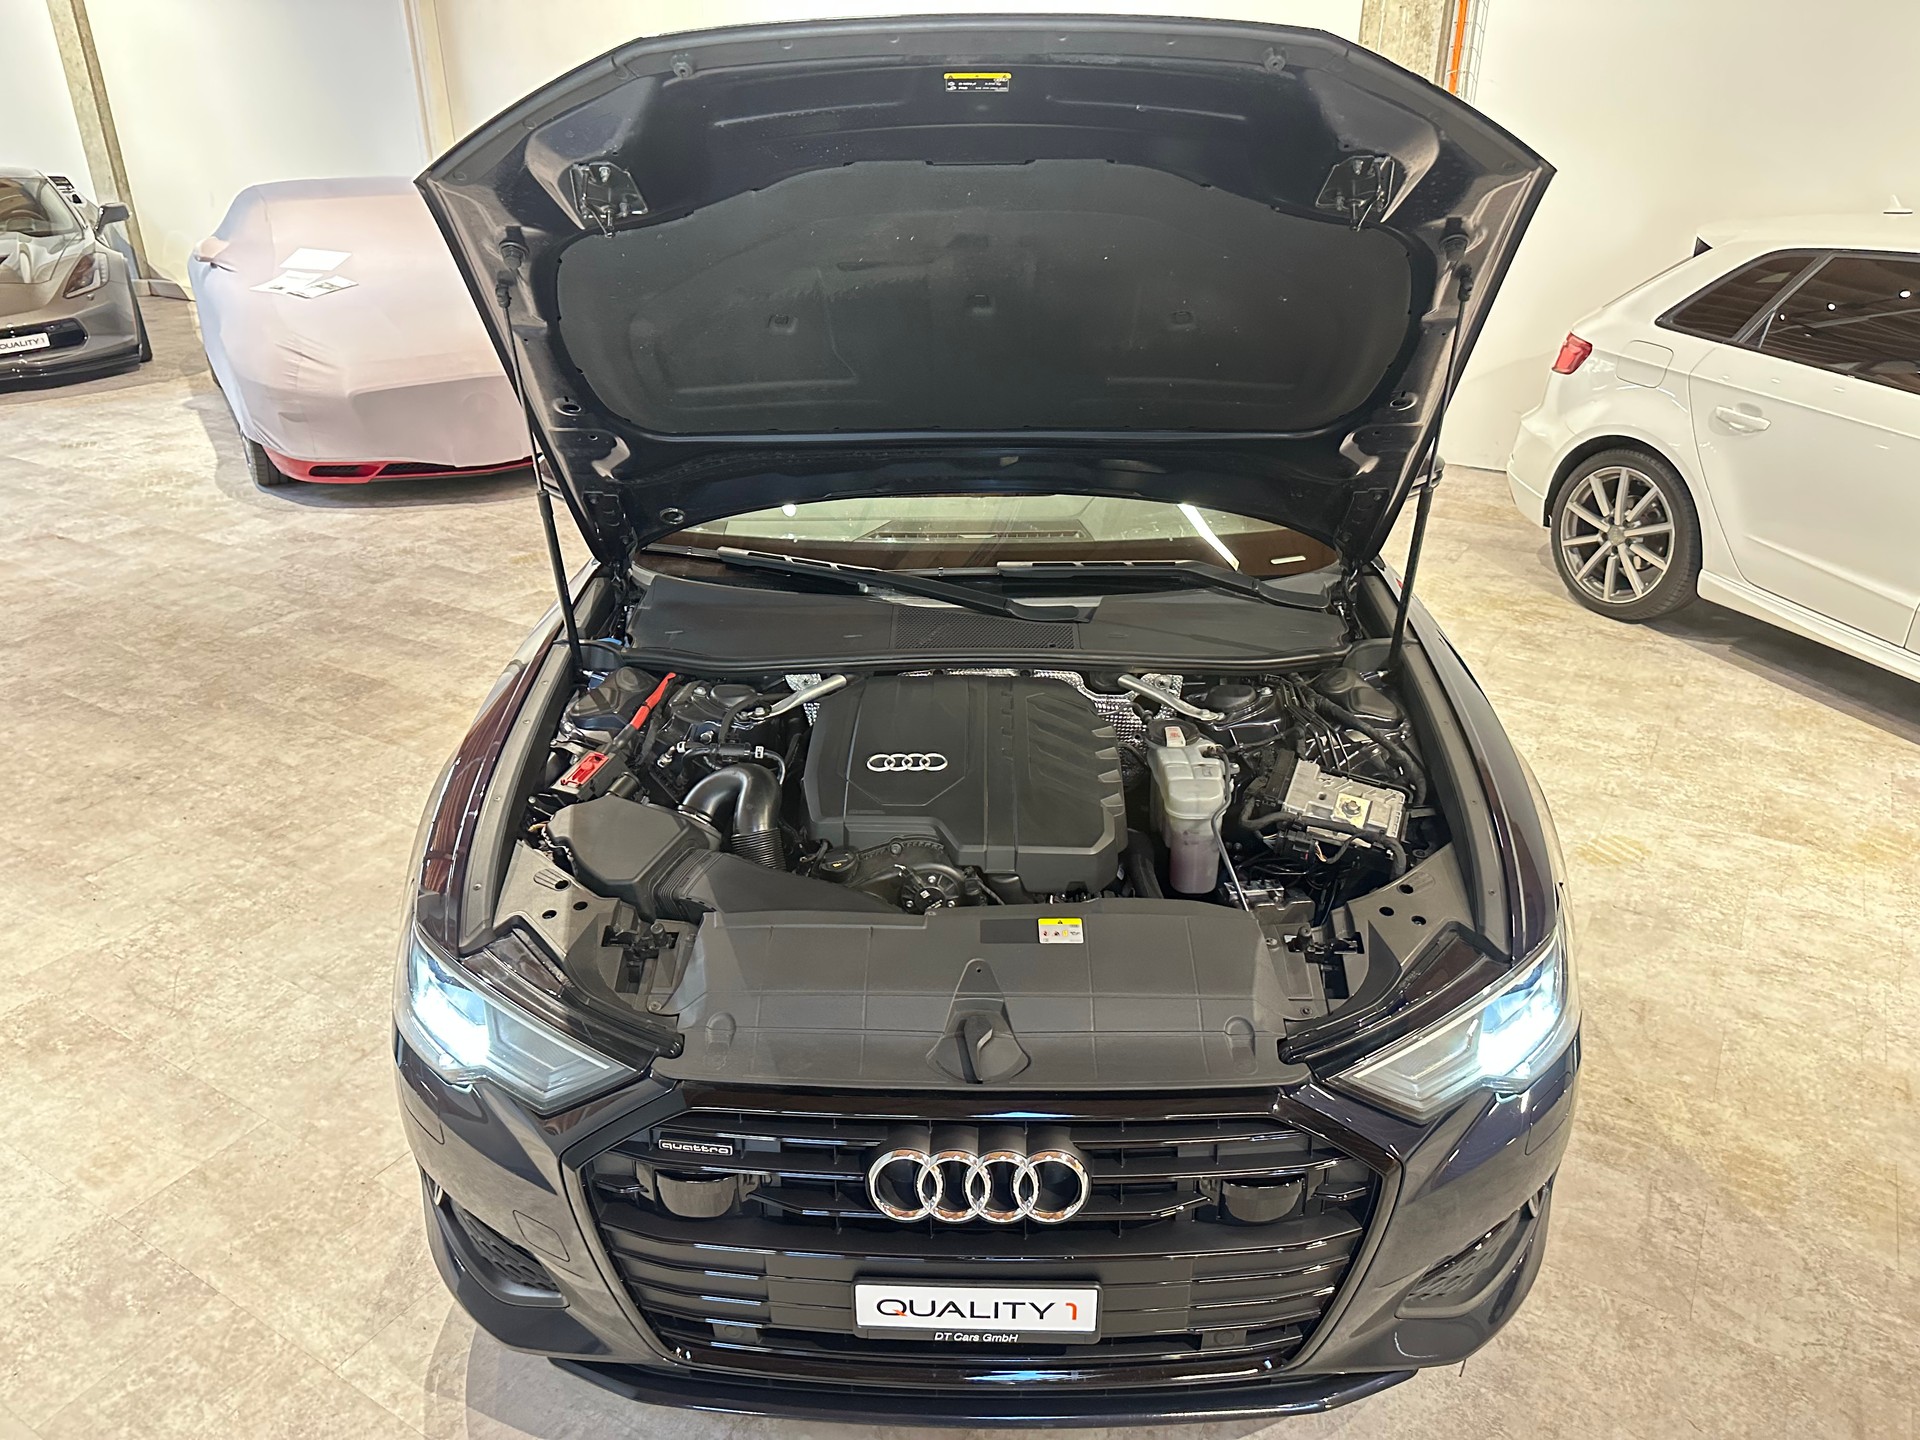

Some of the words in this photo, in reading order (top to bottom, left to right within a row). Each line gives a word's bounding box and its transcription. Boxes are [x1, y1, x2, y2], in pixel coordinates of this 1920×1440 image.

[661, 1142, 729, 1154] quattro
[876, 1299, 1056, 1320] QUALITY
[1065, 1302, 1078, 1320] 1
[934, 1332, 952, 1341] DT
[953, 1333, 980, 1342] Cars
[982, 1333, 1019, 1343] GmbH
